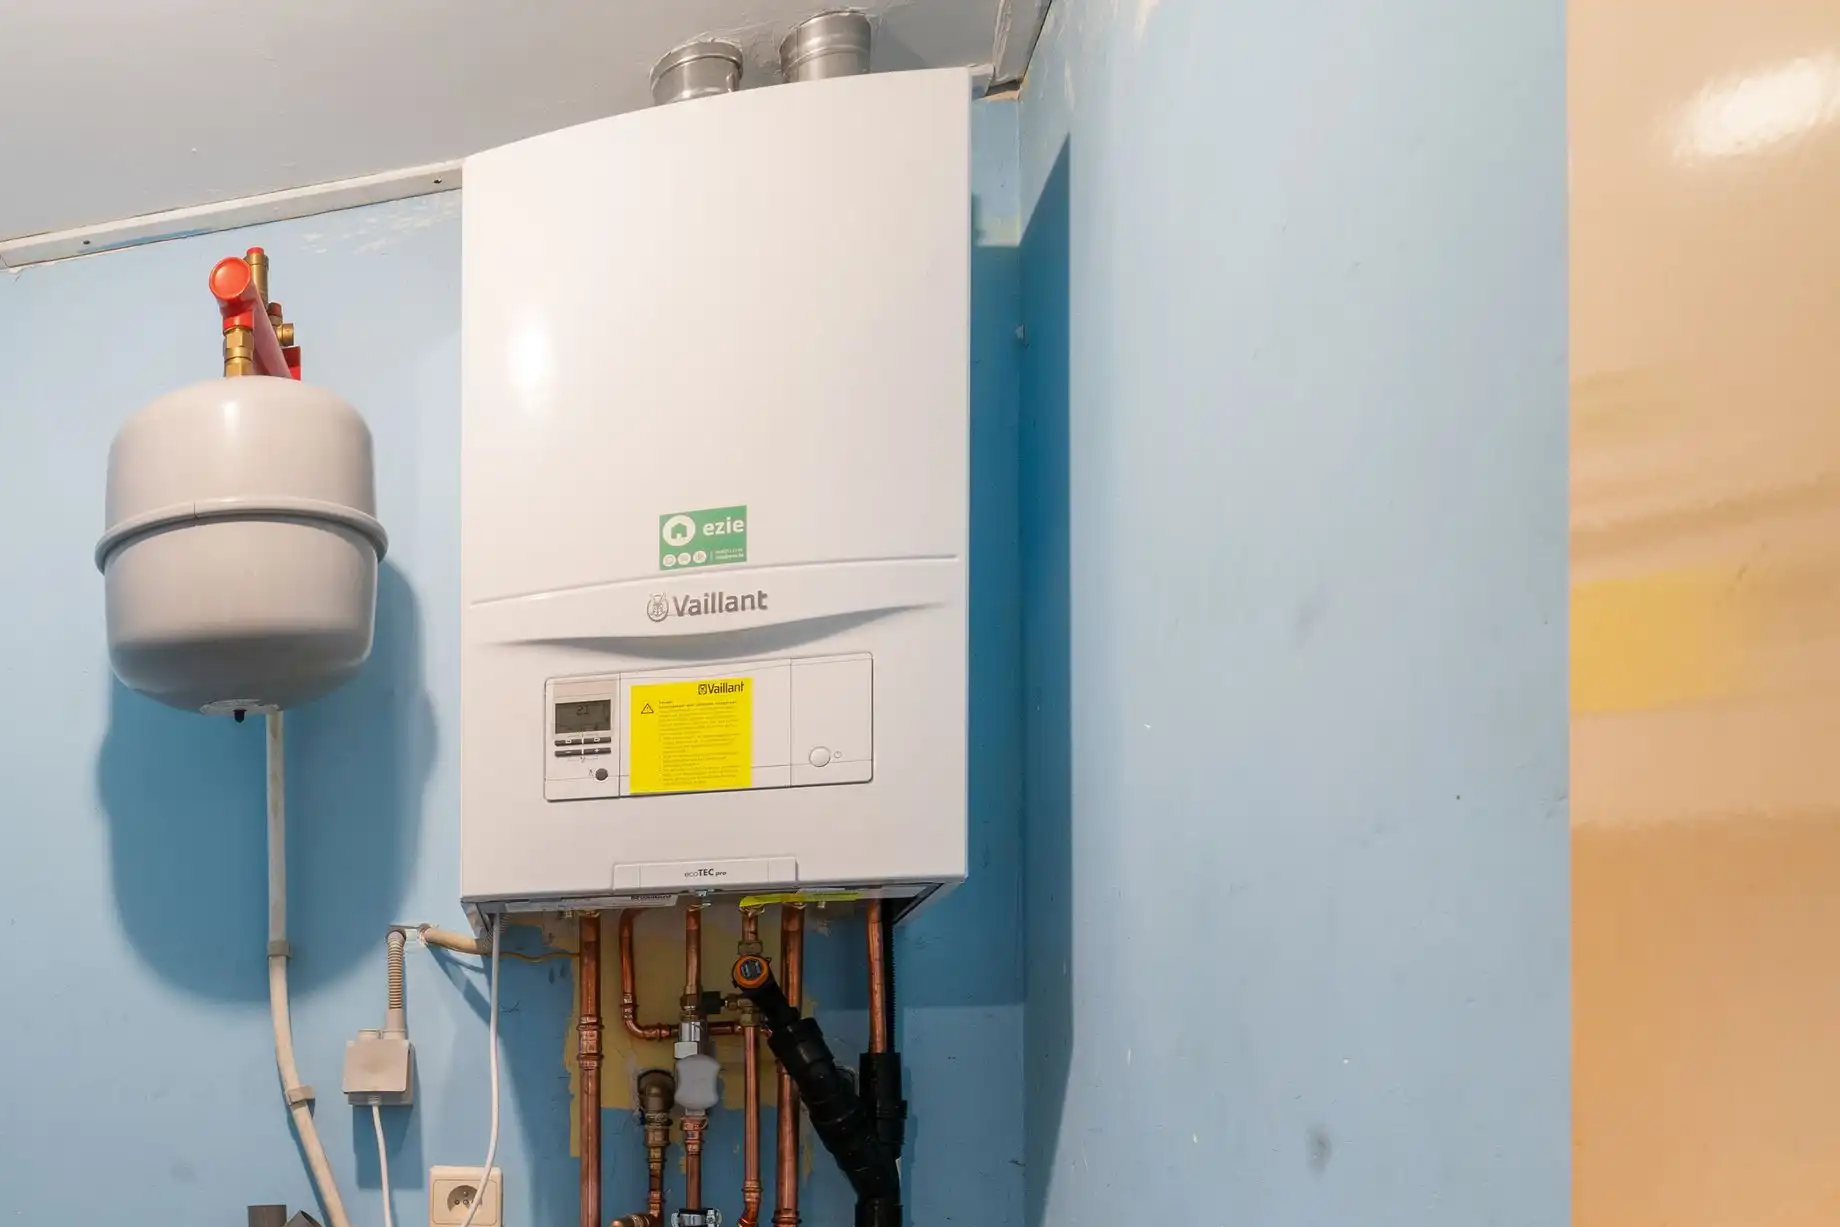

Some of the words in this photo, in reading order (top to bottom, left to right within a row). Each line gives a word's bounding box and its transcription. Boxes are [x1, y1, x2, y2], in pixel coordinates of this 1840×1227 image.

[702, 516, 745, 536] ezie
[672, 590, 768, 617] Vaillant
[707, 681, 745, 694] Vaillant
[684, 868, 714, 878] ecoTEC
